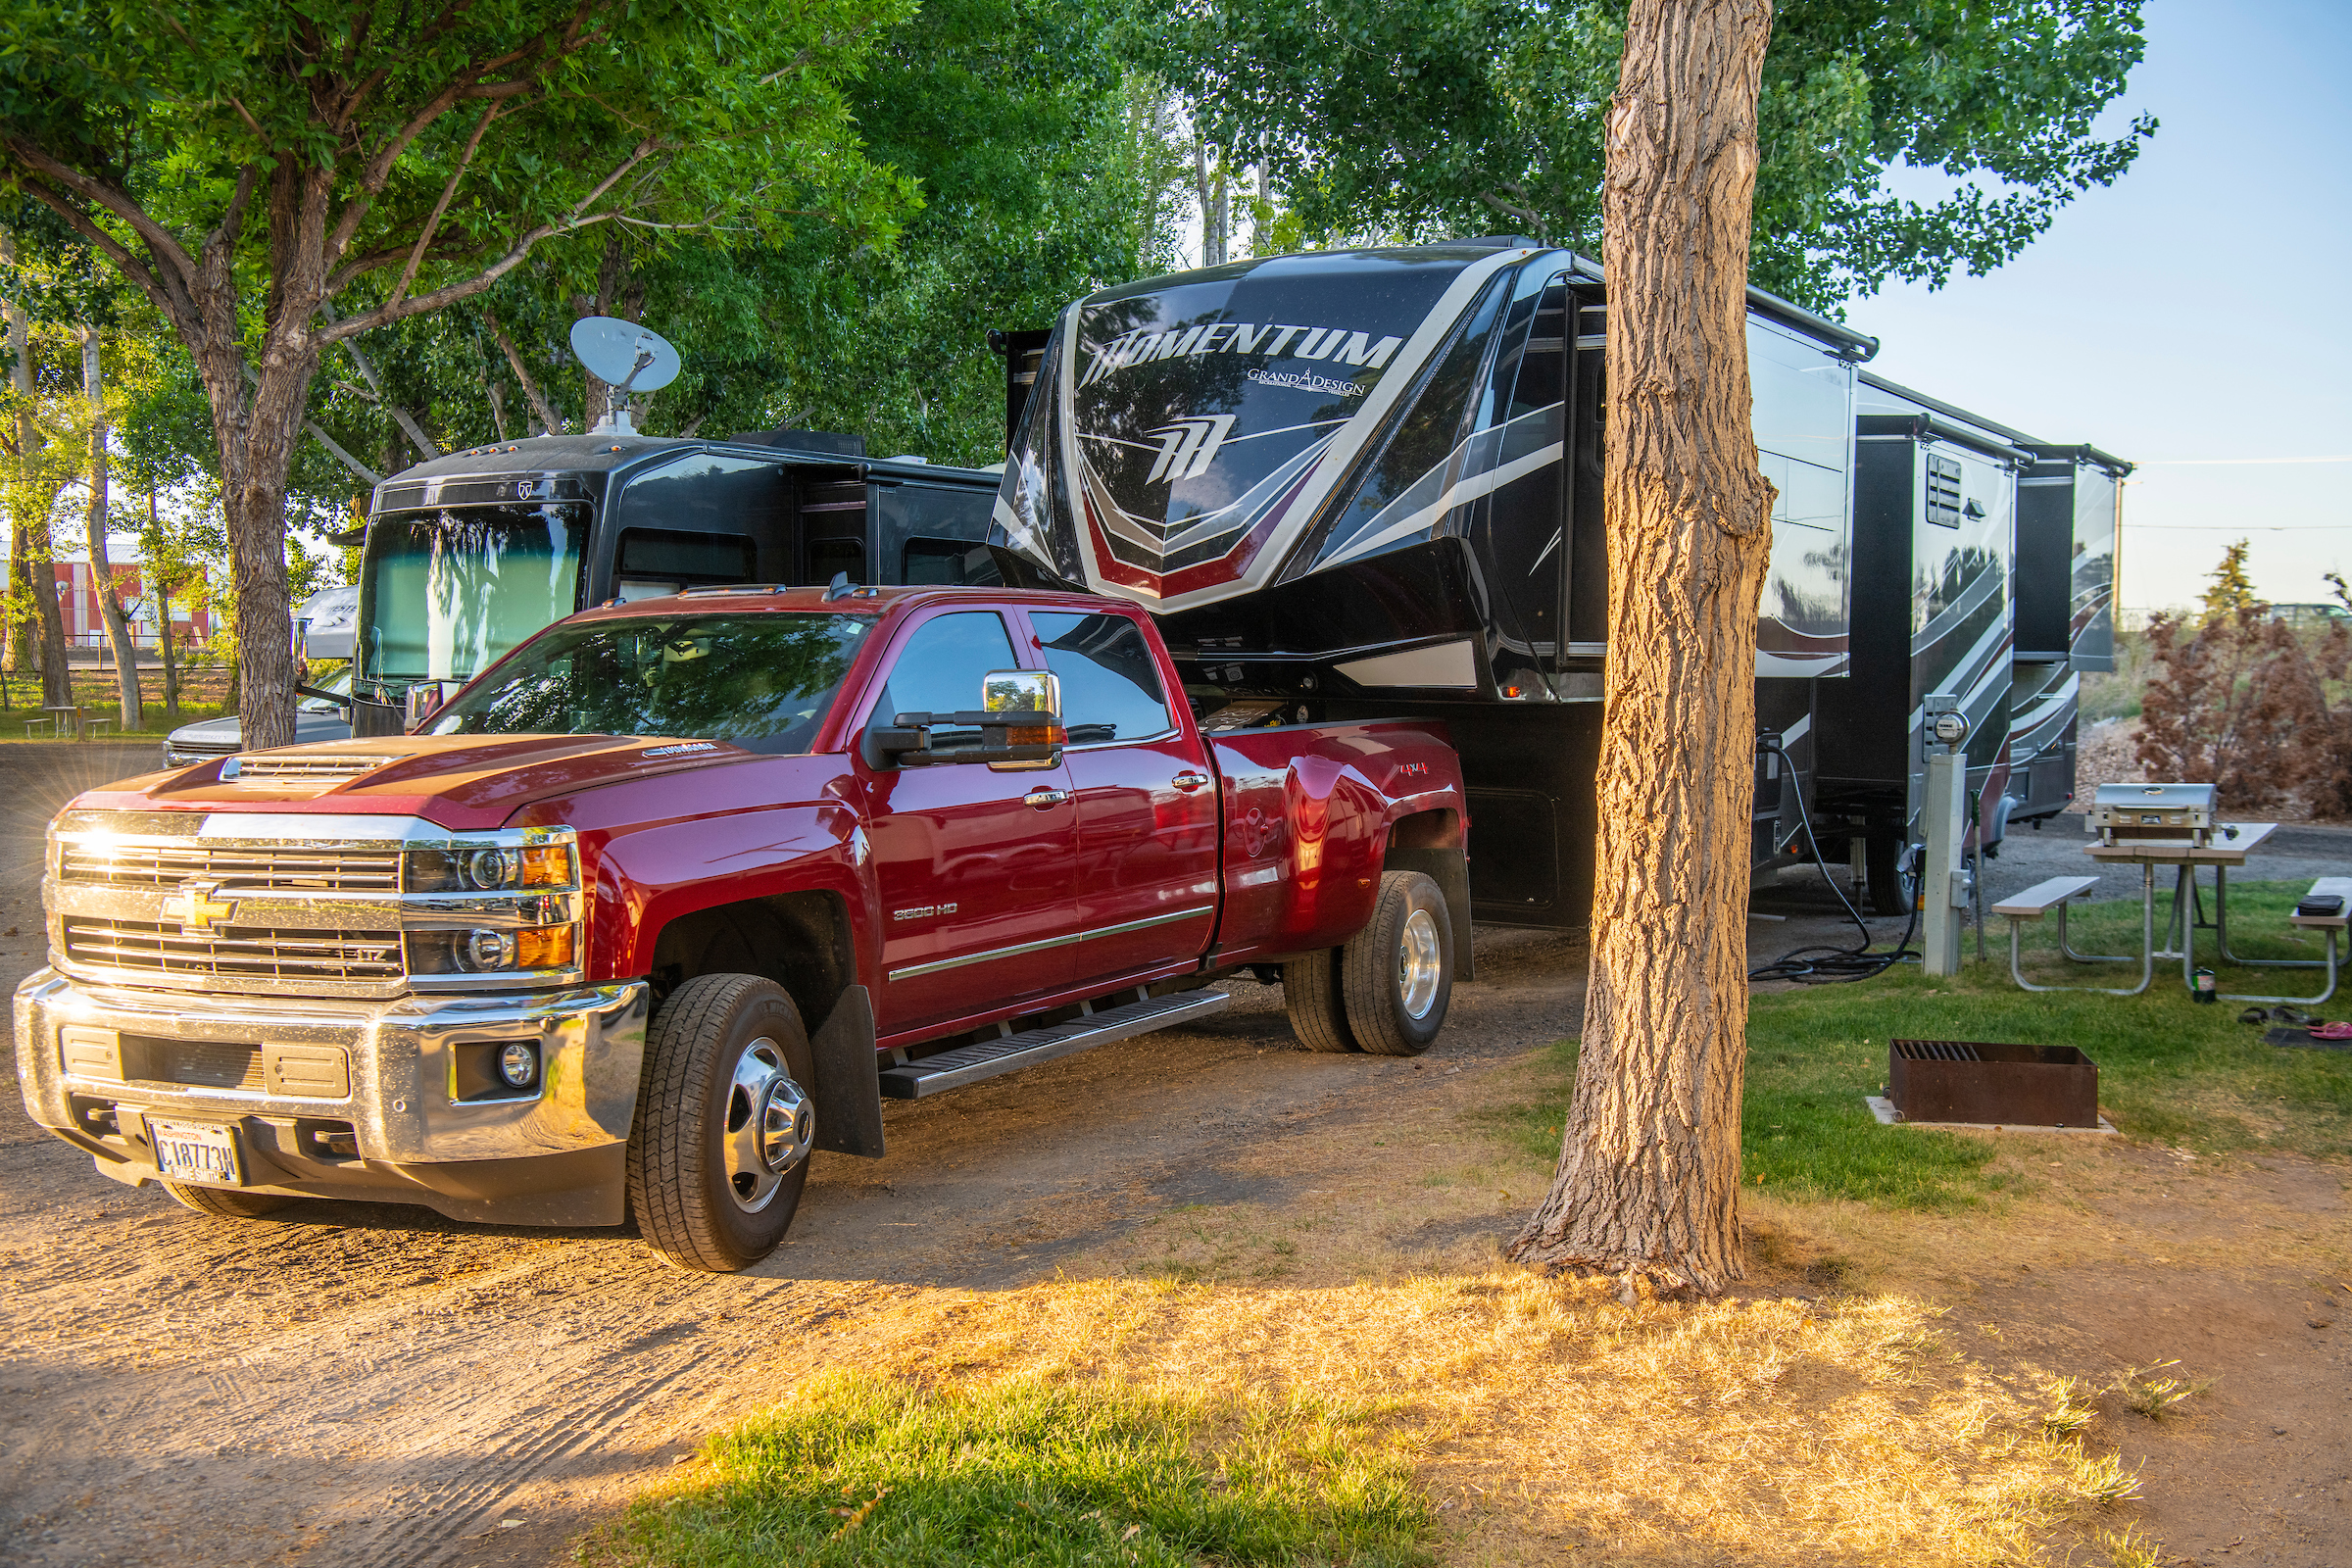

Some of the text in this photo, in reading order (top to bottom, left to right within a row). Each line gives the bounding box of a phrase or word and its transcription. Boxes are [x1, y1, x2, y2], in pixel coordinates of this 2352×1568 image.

[1078, 323, 1402, 391] MOMENTUM
[1247, 368, 1366, 395] GRAND DESIGN
[894, 903, 957, 920] 3500 HD
[157, 1129, 201, 1141] WASHINGTON
[159, 1139, 235, 1175] C18773N
[174, 1166, 220, 1184] DAVE SMITH
